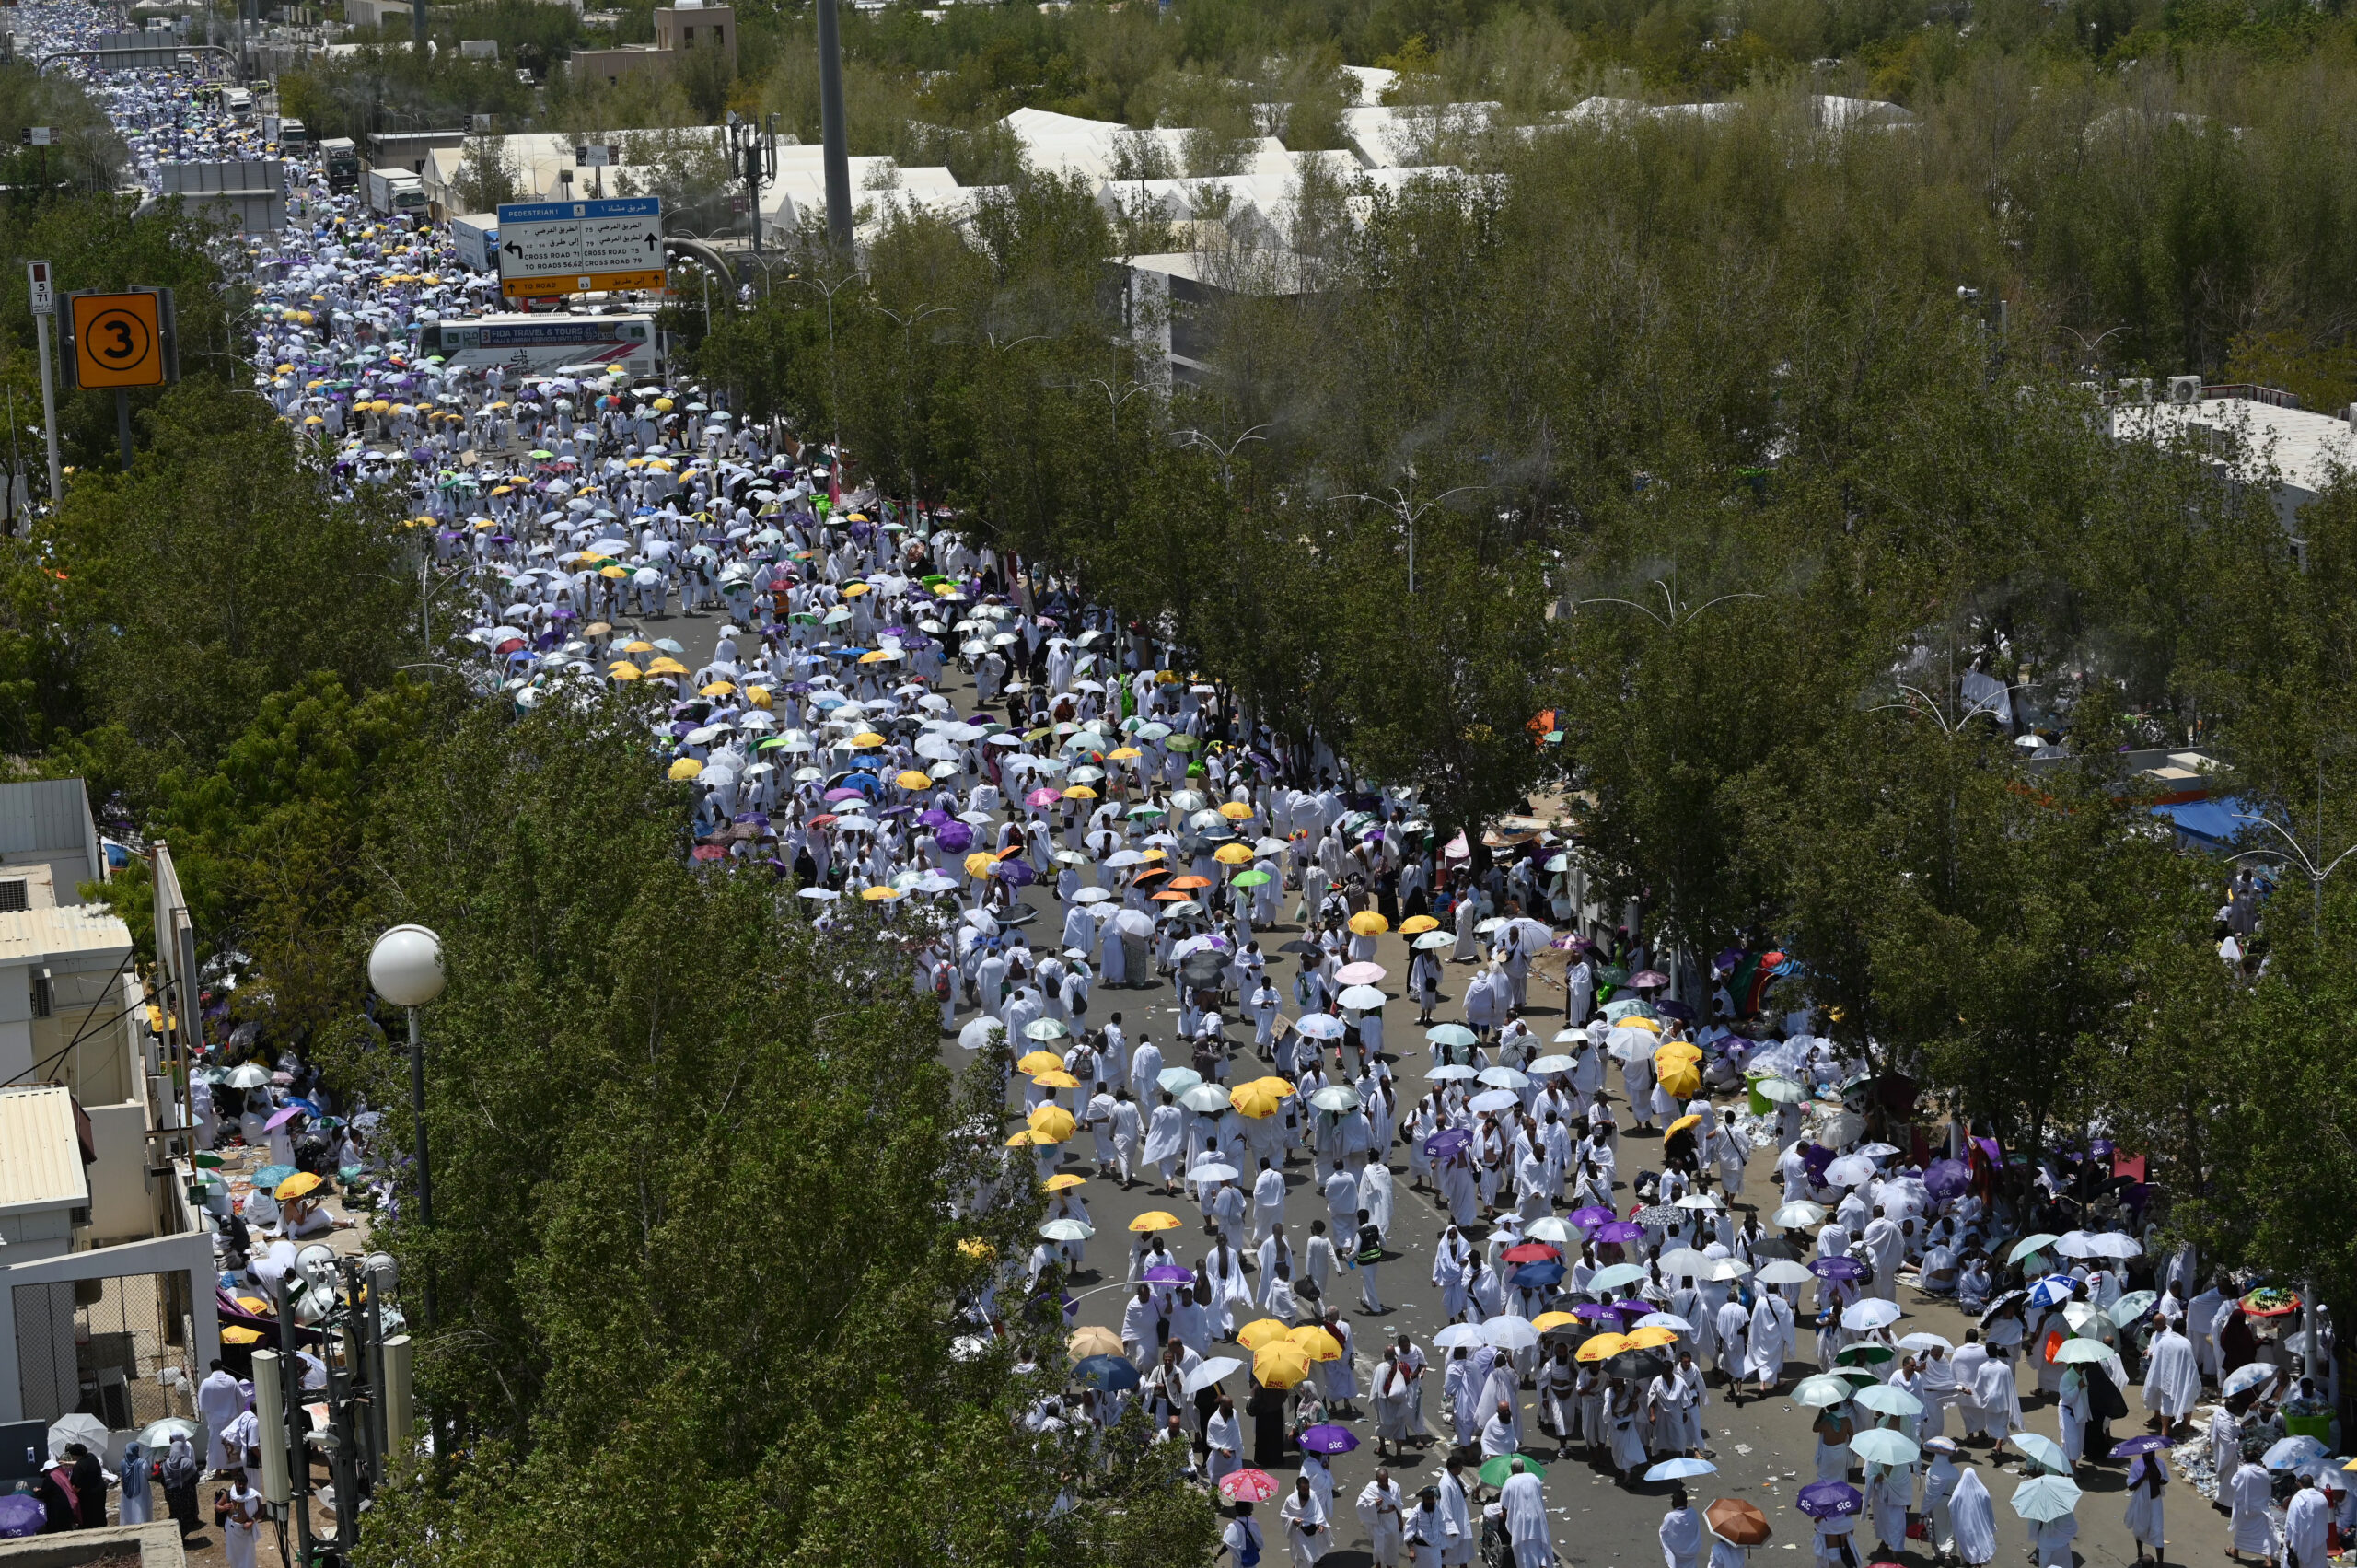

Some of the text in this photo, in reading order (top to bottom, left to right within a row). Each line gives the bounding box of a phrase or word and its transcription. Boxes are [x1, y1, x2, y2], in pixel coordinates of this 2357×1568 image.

[608, 203, 625, 212] مشاة
[627, 203, 647, 212] طريق
[508, 209, 554, 217] PEDESTRIAN
[558, 225, 578, 234] الطريق
[598, 223, 621, 233] العرضي
[621, 222, 642, 231] الطريق
[534, 226, 557, 237] العرضي
[550, 238, 566, 247] طرق
[599, 234, 621, 245] العرضي
[622, 234, 643, 242] الطريق
[613, 278, 632, 286] طريق
[39, 283, 46, 292] 5
[37, 294, 48, 302] 71
[492, 327, 584, 338] FIDA TRAVEL & TOURS
[104, 320, 134, 358] 3
[1007, 877, 1018, 885] stc
[1457, 1138, 1469, 1147] stc
[1427, 1147, 1437, 1156] stc
[2092, 1147, 2106, 1156] stc
[1938, 1188, 1952, 1196] stc
[1585, 1216, 1598, 1225] stc
[1817, 1267, 1829, 1277] stc
[1329, 1440, 1343, 1449] stc
[2143, 1441, 2159, 1450] stc
[1801, 1500, 1811, 1511] stc
[1836, 1501, 1852, 1512] stc
